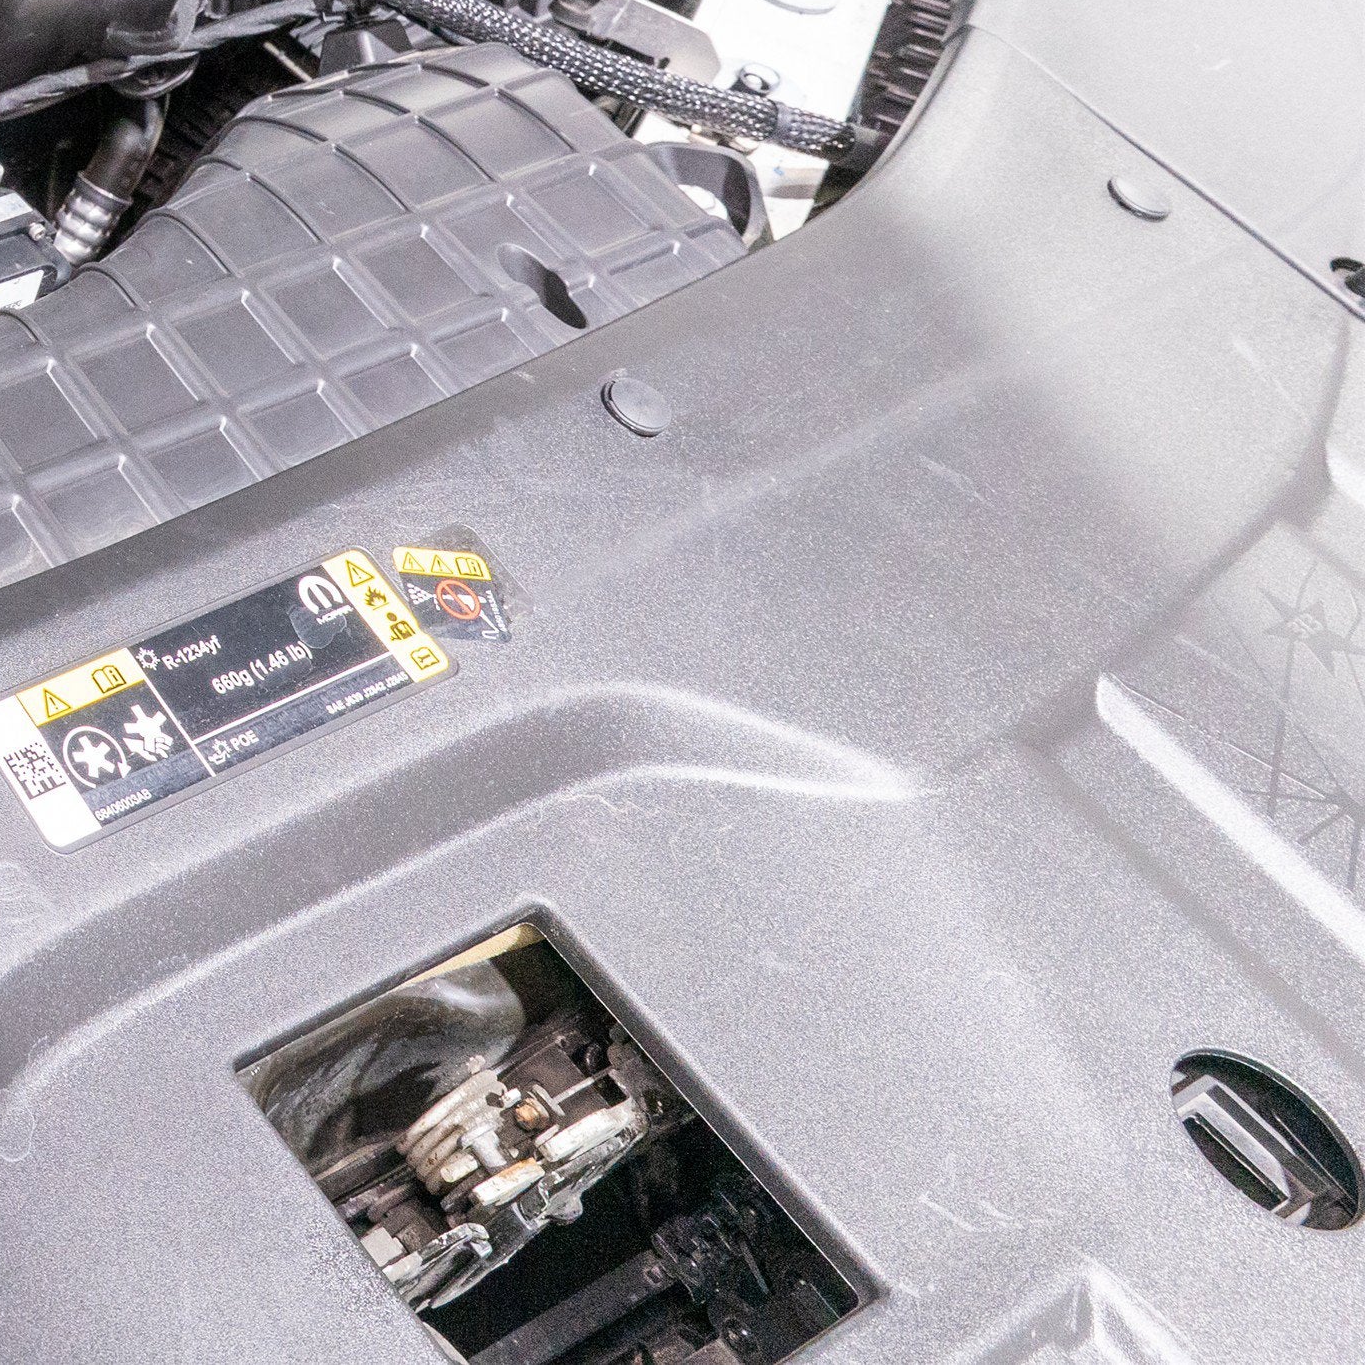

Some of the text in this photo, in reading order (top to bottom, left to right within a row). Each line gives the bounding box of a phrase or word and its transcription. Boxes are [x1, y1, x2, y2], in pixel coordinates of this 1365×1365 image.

[162, 635, 222, 670] R-1234yf
[211, 640, 313, 694] 660g (1.46 lb)
[325, 699, 346, 715] SAE
[230, 729, 259, 751] POE
